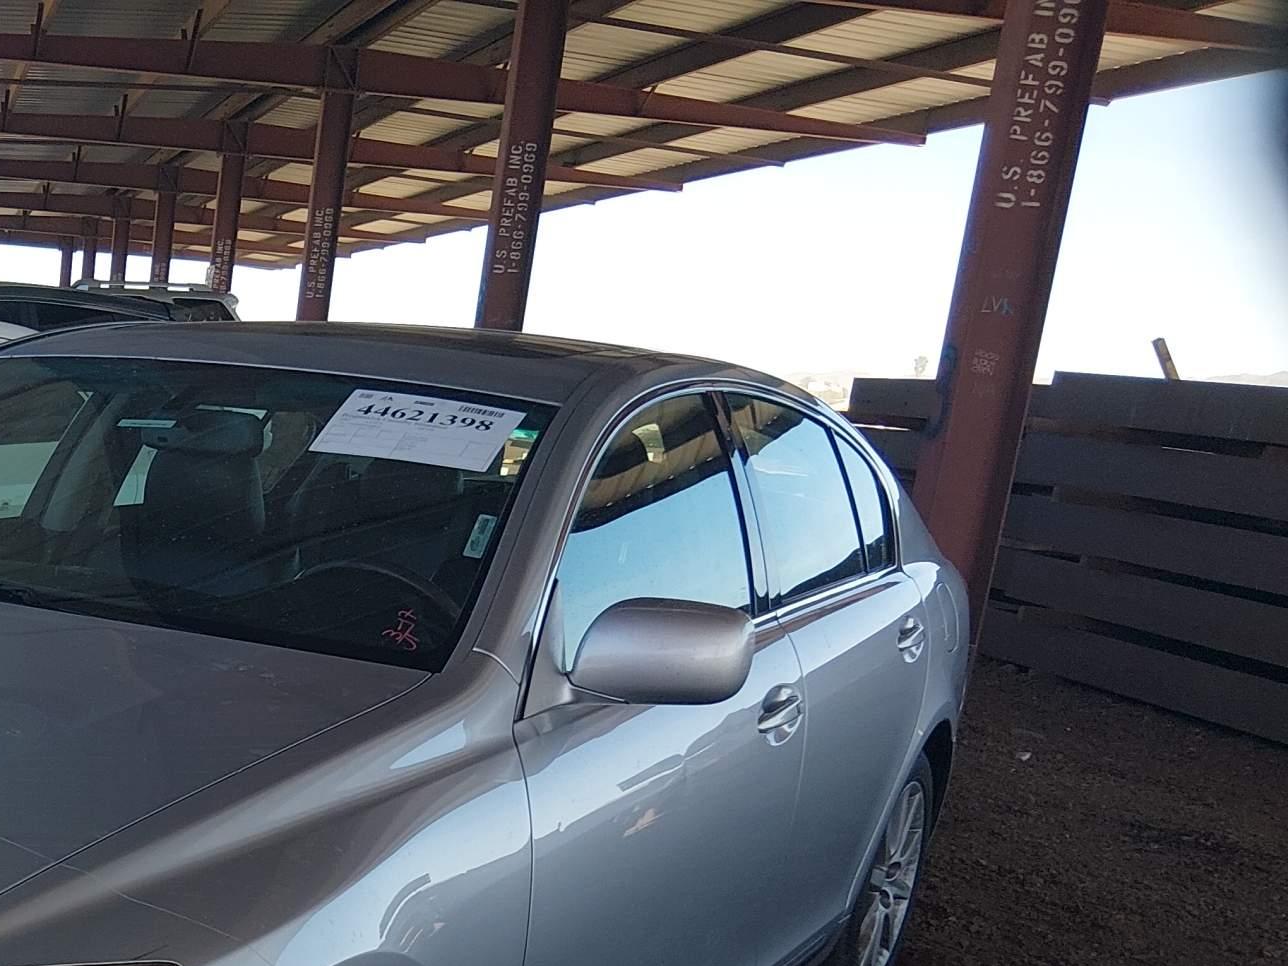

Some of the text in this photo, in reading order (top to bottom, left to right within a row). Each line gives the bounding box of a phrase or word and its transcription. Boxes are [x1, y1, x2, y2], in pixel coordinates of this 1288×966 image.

[1008, 32, 1049, 140] PREFAB
[1020, 0, 1082, 208] 1-866-799-09
[508, 140, 525, 169] INC.
[498, 177, 519, 237] PREFAB
[308, 231, 322, 273] PREFAB
[356, 402, 496, 432] 44621398
